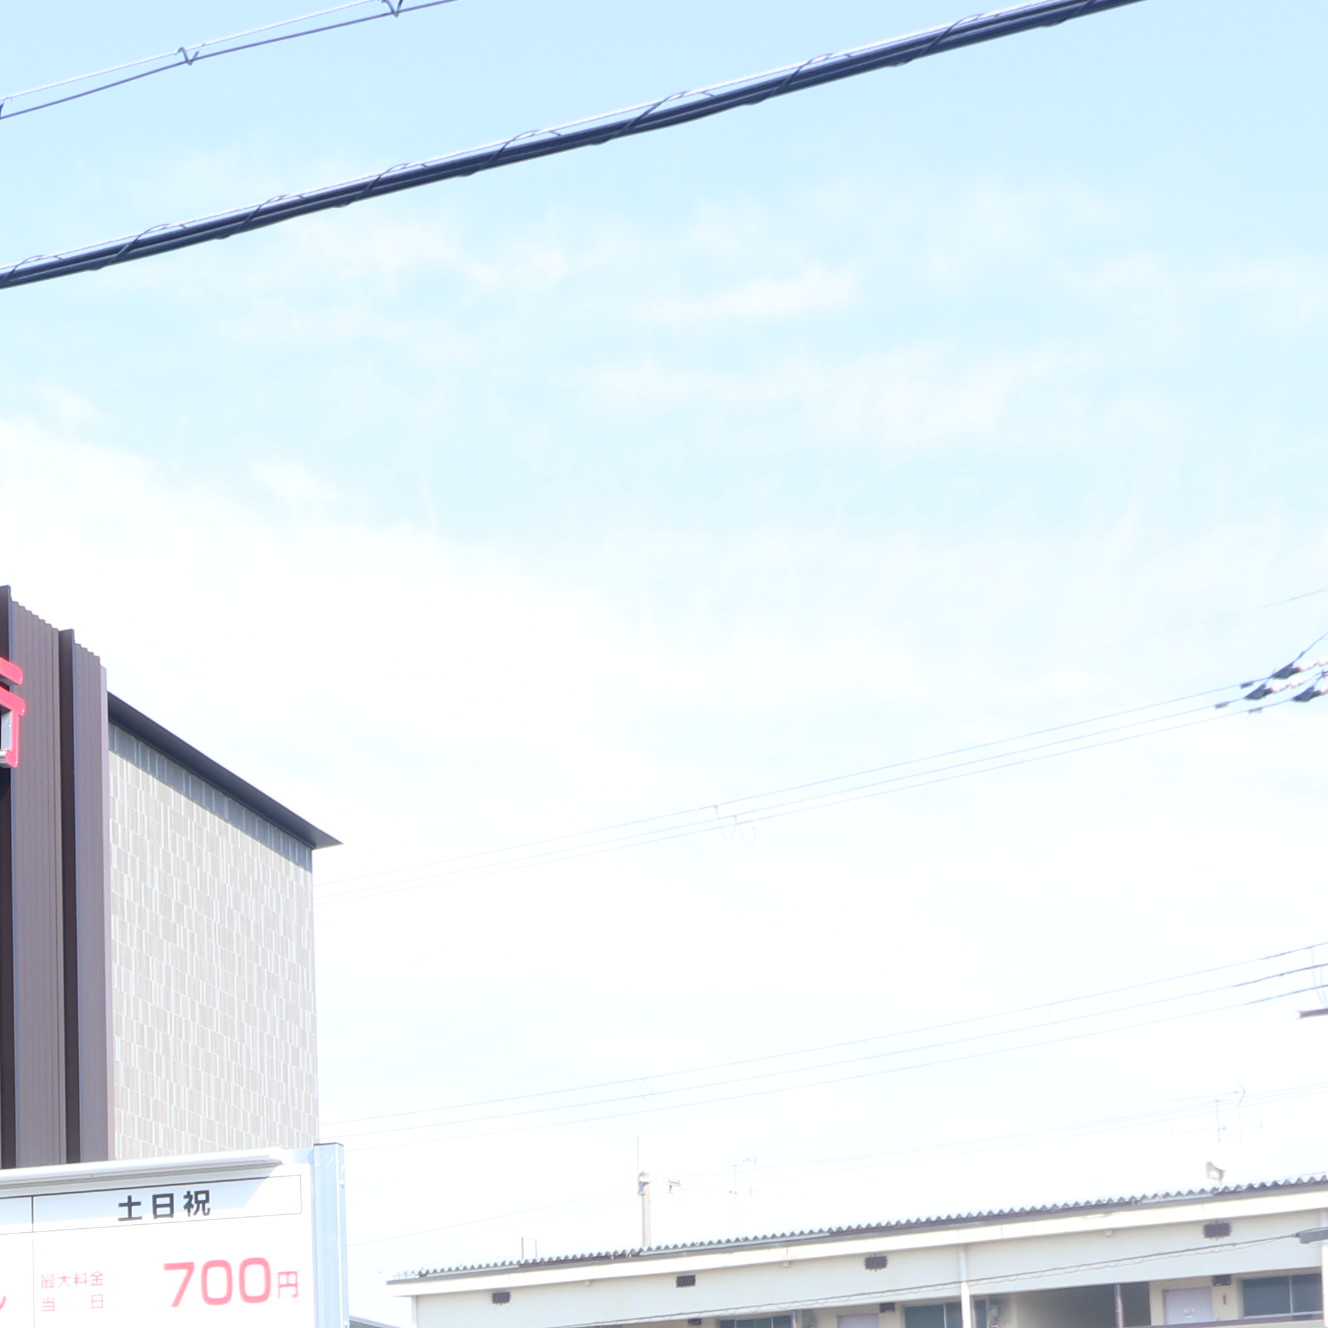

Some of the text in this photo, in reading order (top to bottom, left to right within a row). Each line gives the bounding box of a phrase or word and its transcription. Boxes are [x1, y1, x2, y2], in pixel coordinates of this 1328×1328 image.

[117, 1189, 212, 1222] 土日祝
[40, 1270, 104, 1289] 最大料金
